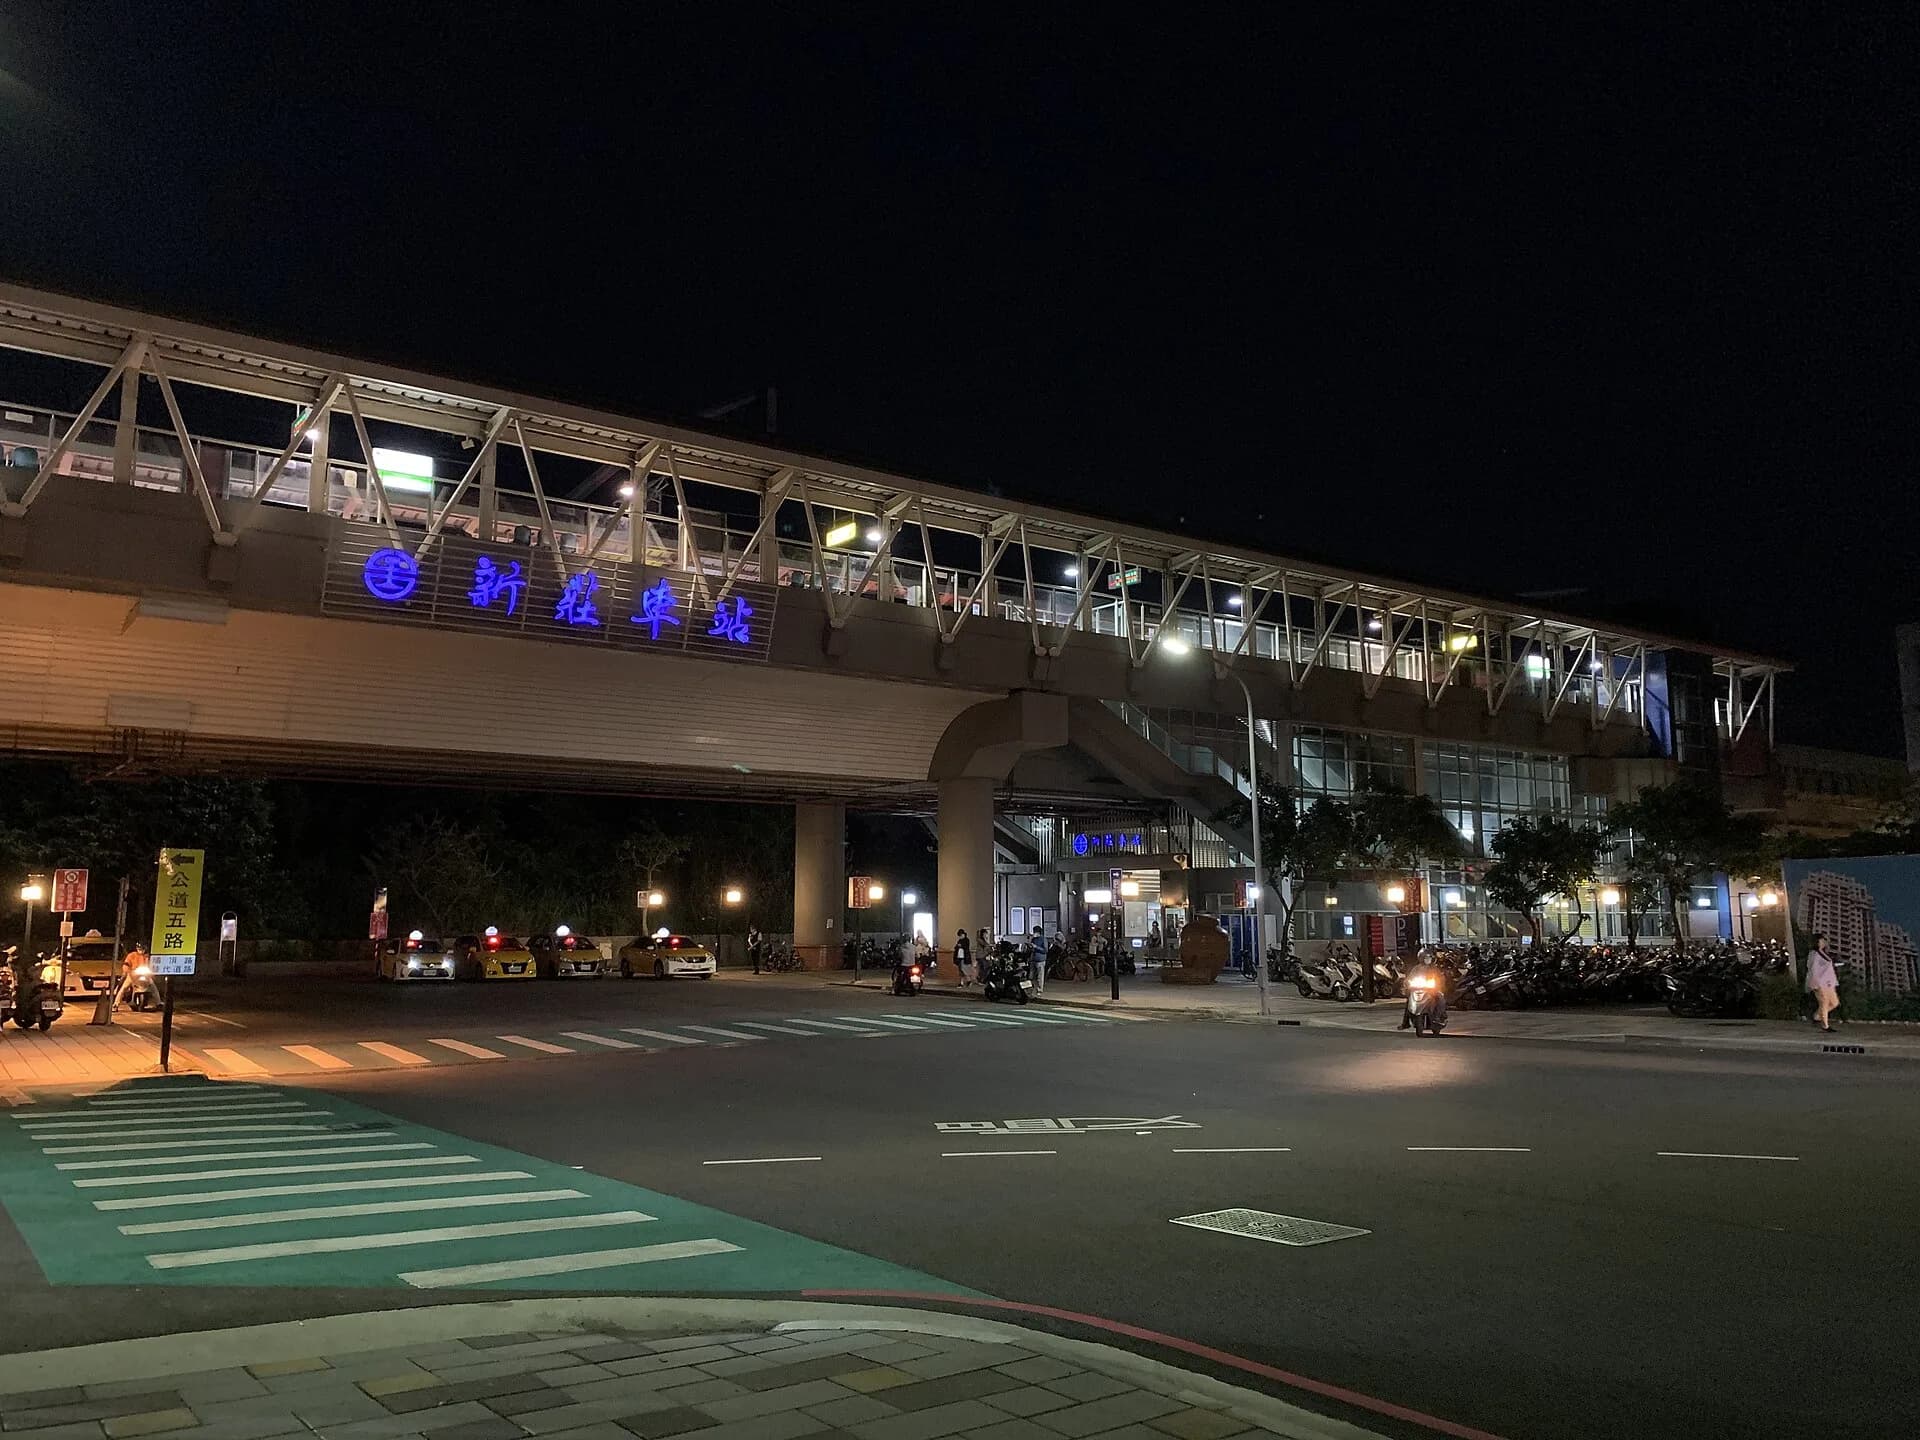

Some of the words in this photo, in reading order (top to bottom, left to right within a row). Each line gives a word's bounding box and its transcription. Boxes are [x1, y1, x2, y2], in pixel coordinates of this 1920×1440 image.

[467, 556, 752, 643] 新莊車站
[164, 871, 190, 949] 公道五路
